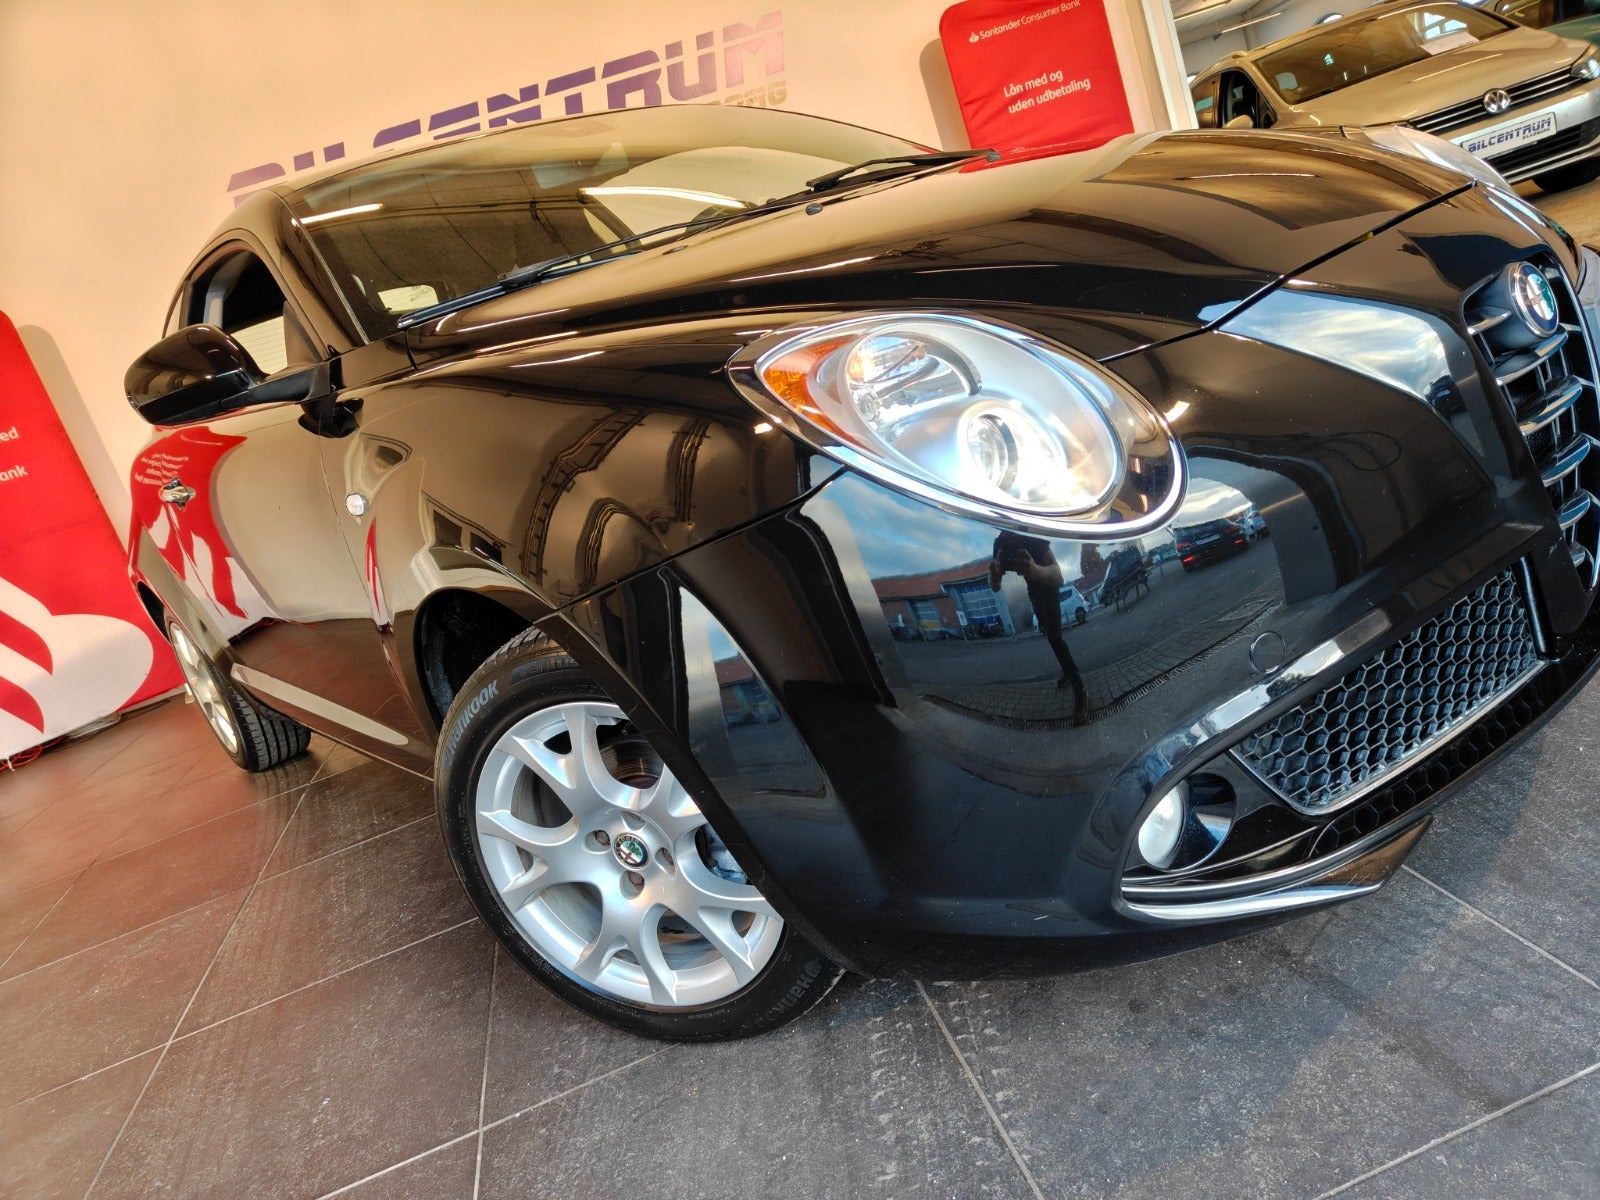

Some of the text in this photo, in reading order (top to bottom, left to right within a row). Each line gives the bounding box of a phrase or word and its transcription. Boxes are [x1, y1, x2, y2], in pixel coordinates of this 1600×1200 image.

[980, 0, 1081, 39] Santander Consumer Bank
[1003, 70, 1064, 98] Lån med og
[1008, 78, 1091, 114] uden udbetaling
[1468, 117, 1552, 153] BILCENTRUM
